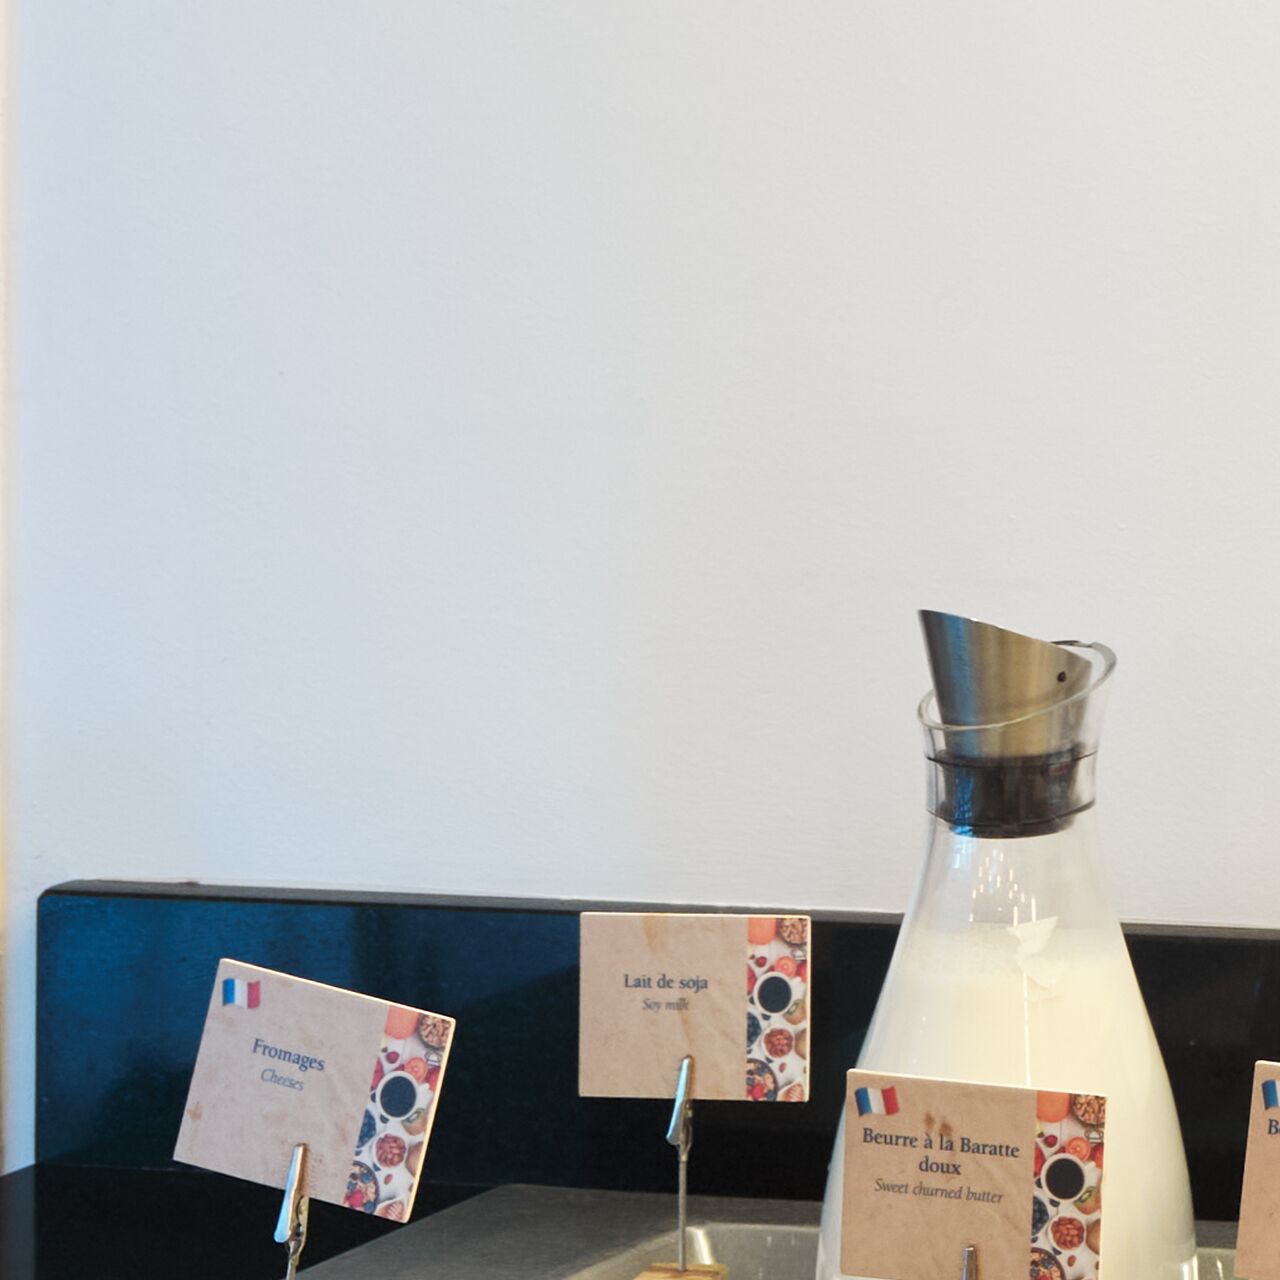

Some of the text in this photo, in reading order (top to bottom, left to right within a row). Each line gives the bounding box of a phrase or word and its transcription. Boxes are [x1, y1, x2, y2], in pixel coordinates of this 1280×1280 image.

[623, 973, 709, 994] Lait de soja
[252, 1037, 326, 1073] Fromages
[260, 1068, 305, 1092] Cheeses
[862, 1127, 1021, 1159] Beurre à la Baratte
[918, 1155, 962, 1176] doux
[873, 1178, 1005, 1205] Sweet churned butter
